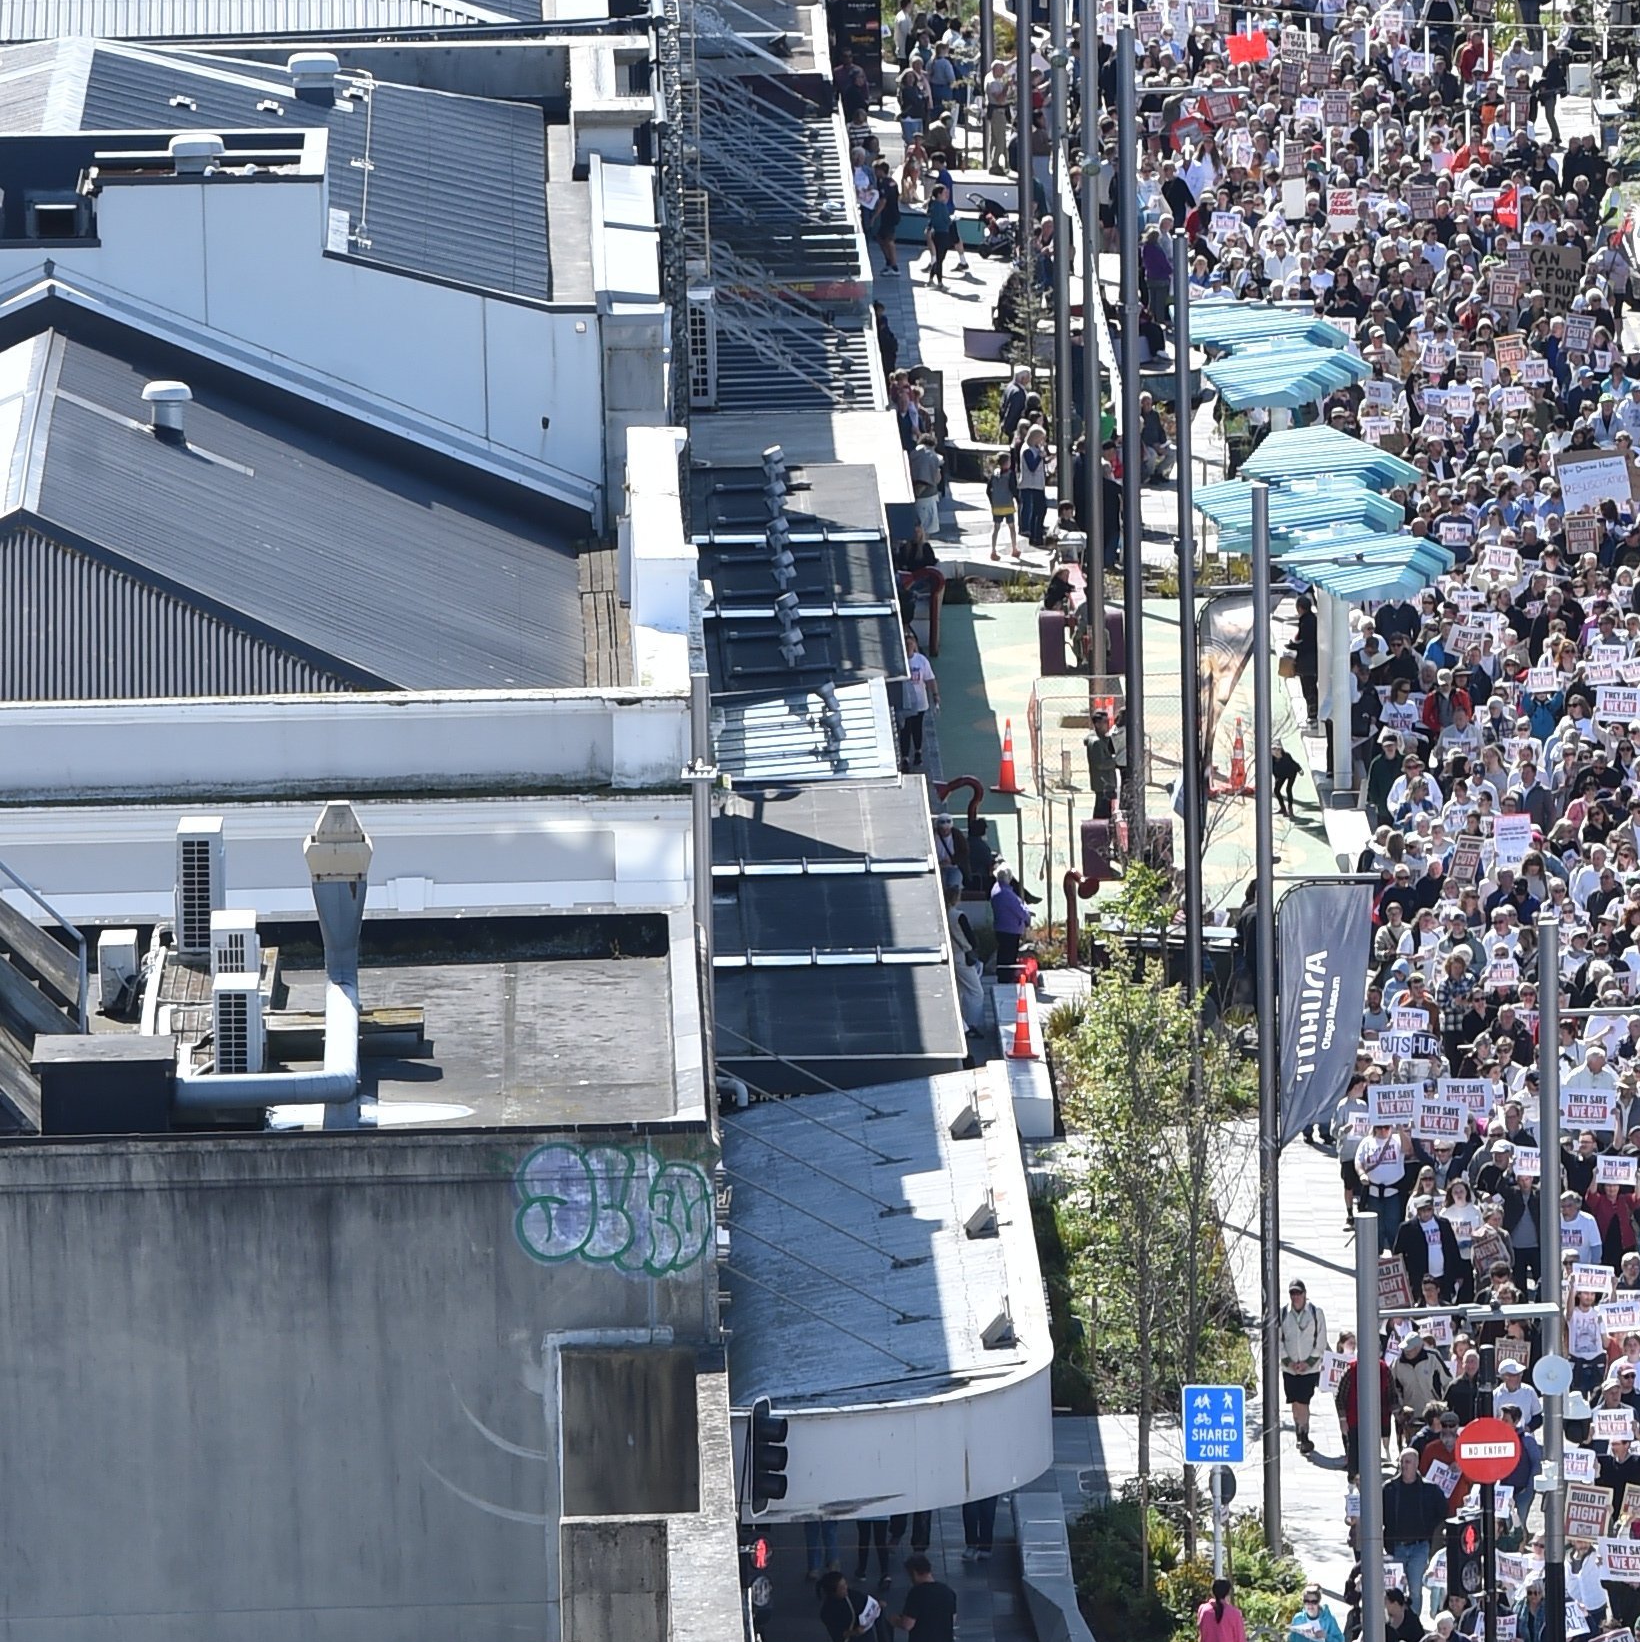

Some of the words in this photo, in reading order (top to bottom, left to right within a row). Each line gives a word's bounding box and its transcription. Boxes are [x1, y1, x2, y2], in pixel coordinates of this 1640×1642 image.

[1530, 249, 1560, 265] CAN
[1535, 268, 1581, 283] FFORD
[1494, 281, 1514, 292] CUTS
[1567, 326, 1590, 339] CUTS
[1568, 521, 1586, 529] BUILD
[1569, 531, 1594, 541] RIGHT
[1604, 691, 1620, 700] THEY
[1621, 691, 1637, 700] SAVE
[1326, 976, 1341, 1018] Museum
[1322, 1019, 1337, 1050] Otago
[1380, 1036, 1411, 1054] CUTS
[1567, 1094, 1587, 1104] THEY
[1588, 1094, 1608, 1104] SAVE
[1572, 1105, 1588, 1118] WE
[1589, 1105, 1604, 1118] PAY
[1191, 1428, 1238, 1442] SHARED
[1199, 1444, 1230, 1457] ZONE
[1468, 1446, 1479, 1456] NO
[1483, 1445, 1507, 1455] ENTRY
[1572, 1491, 1596, 1505] BUILD
[1597, 1495, 1606, 1506] IT
[1569, 1507, 1605, 1522] RIGHT
